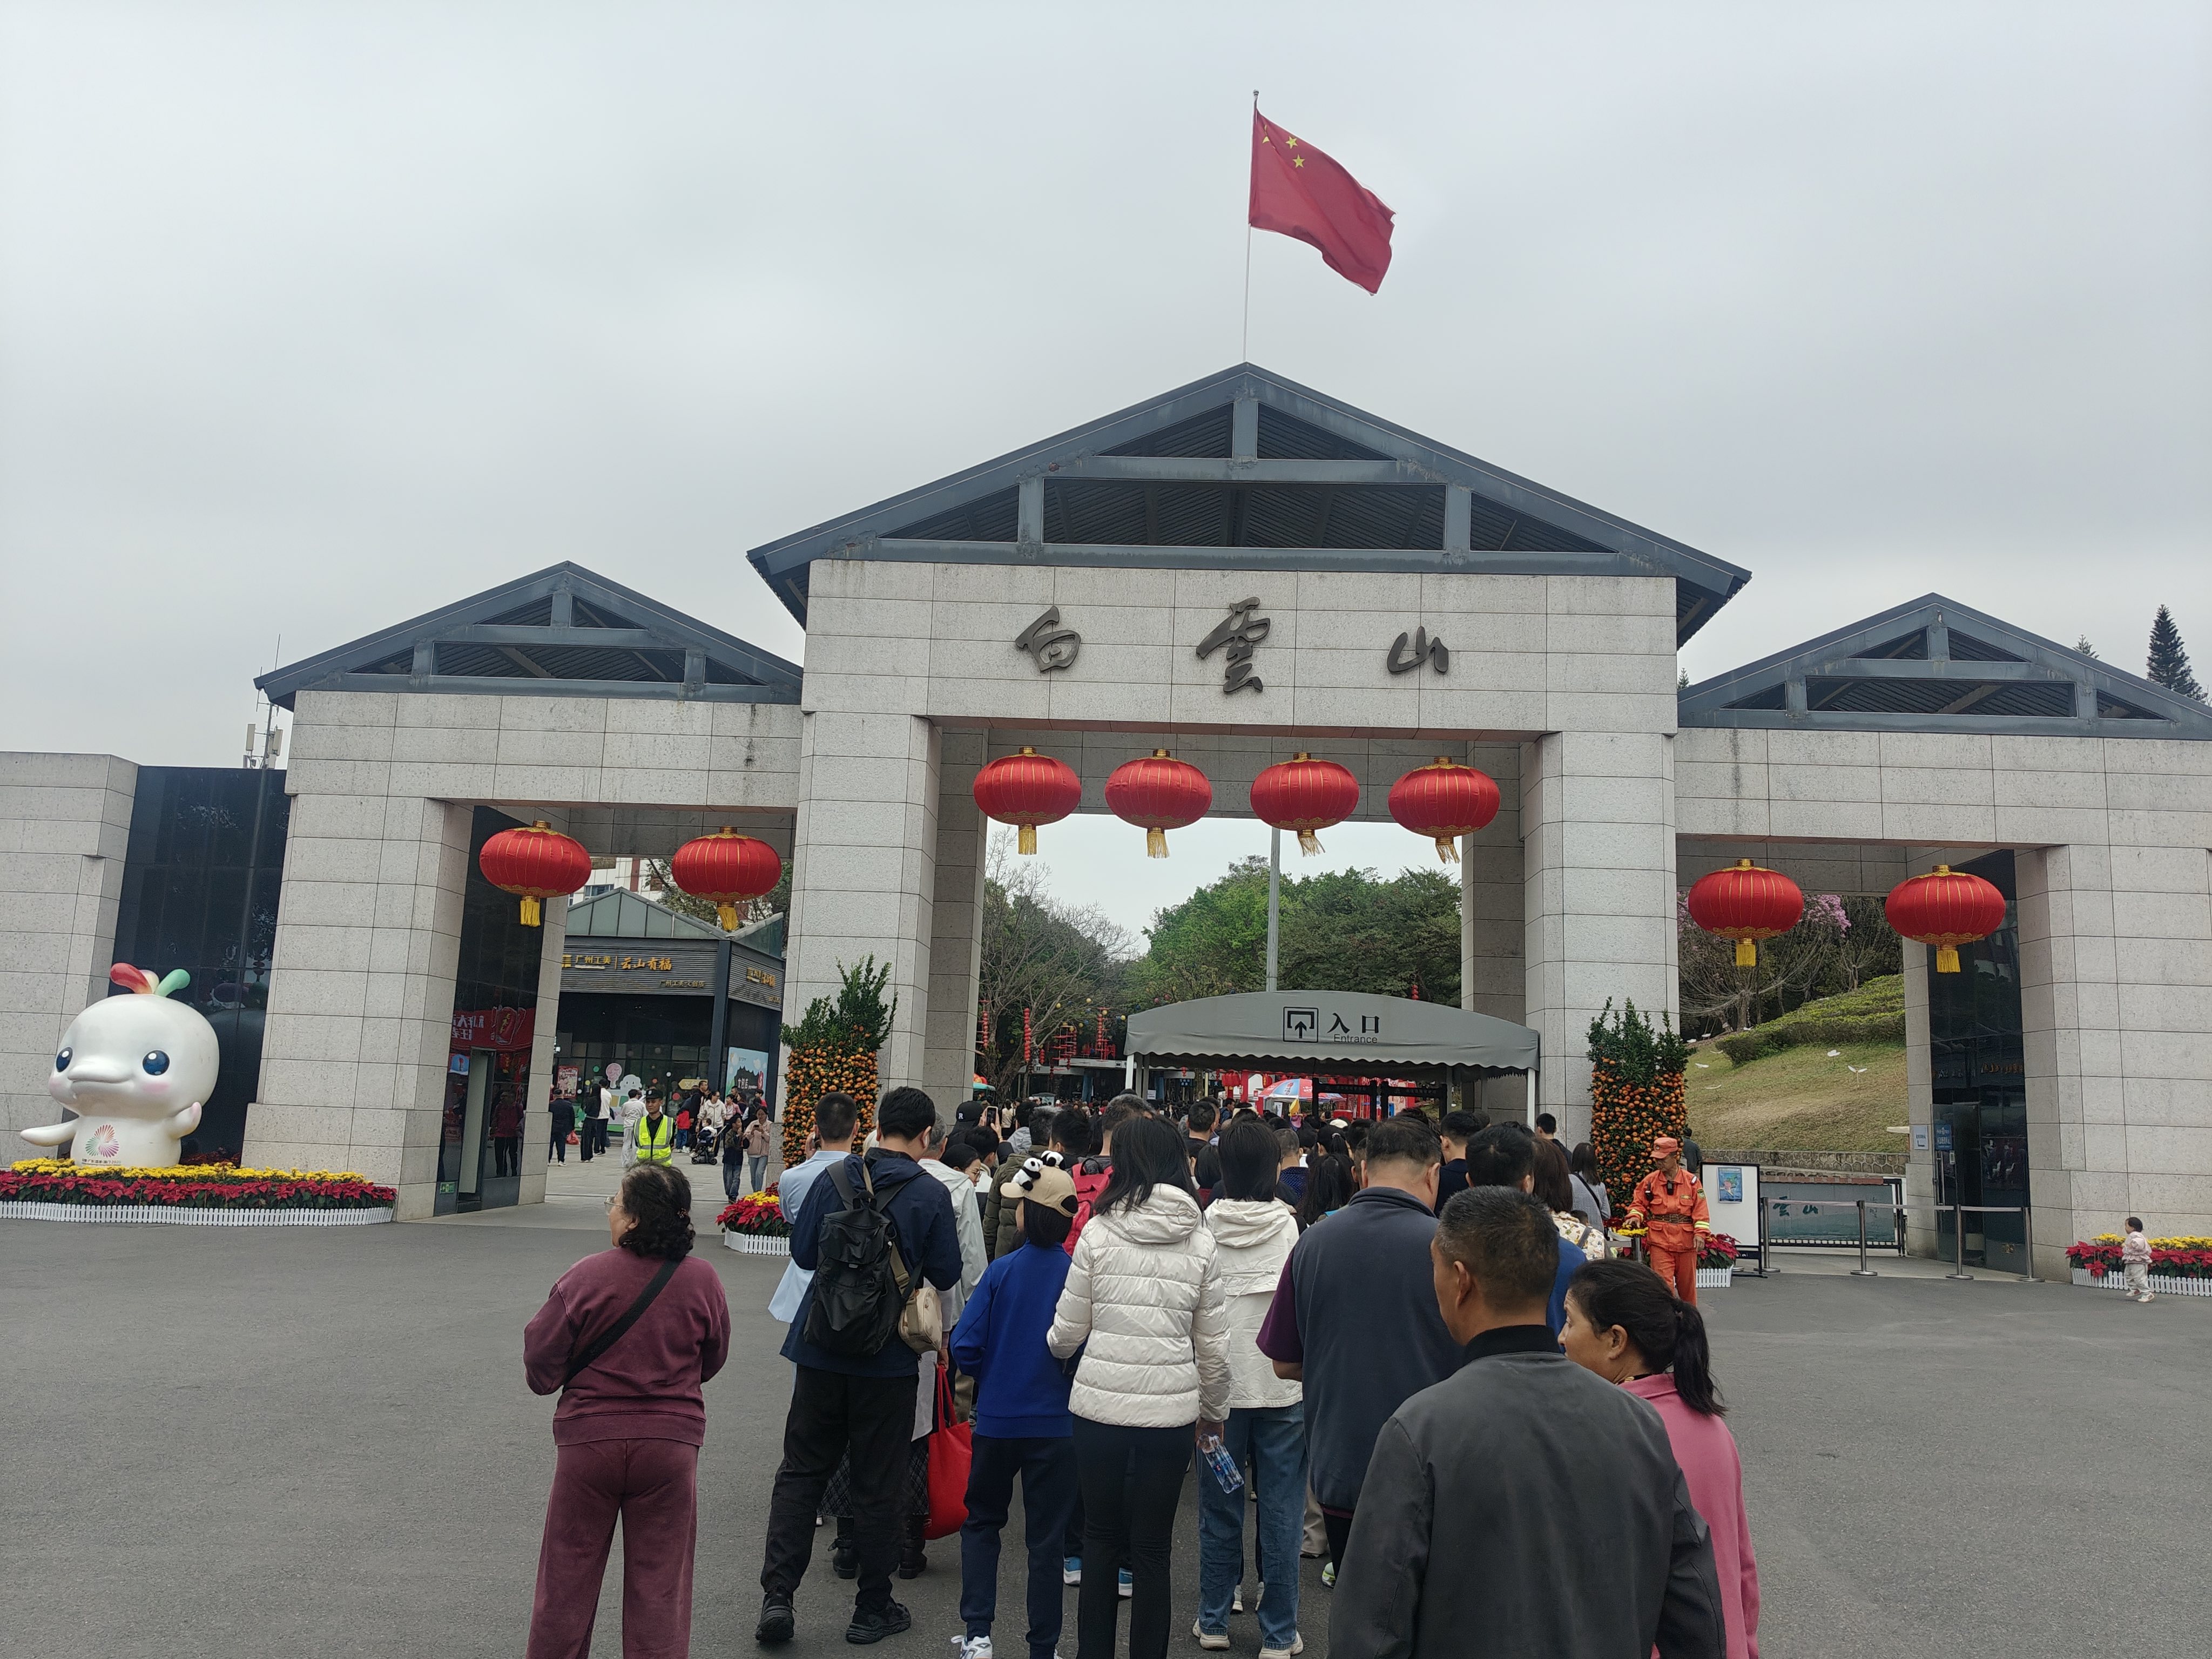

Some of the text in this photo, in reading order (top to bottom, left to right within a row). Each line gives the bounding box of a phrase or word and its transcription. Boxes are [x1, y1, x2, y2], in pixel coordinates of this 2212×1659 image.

[1015, 596, 1449, 694] 白雲山
[622, 957, 672, 971] 云山有福
[1327, 1013, 1380, 1034] 入口
[1334, 1034, 1378, 1044] Entrance
[1760, 1195, 1819, 1217] 雲山
